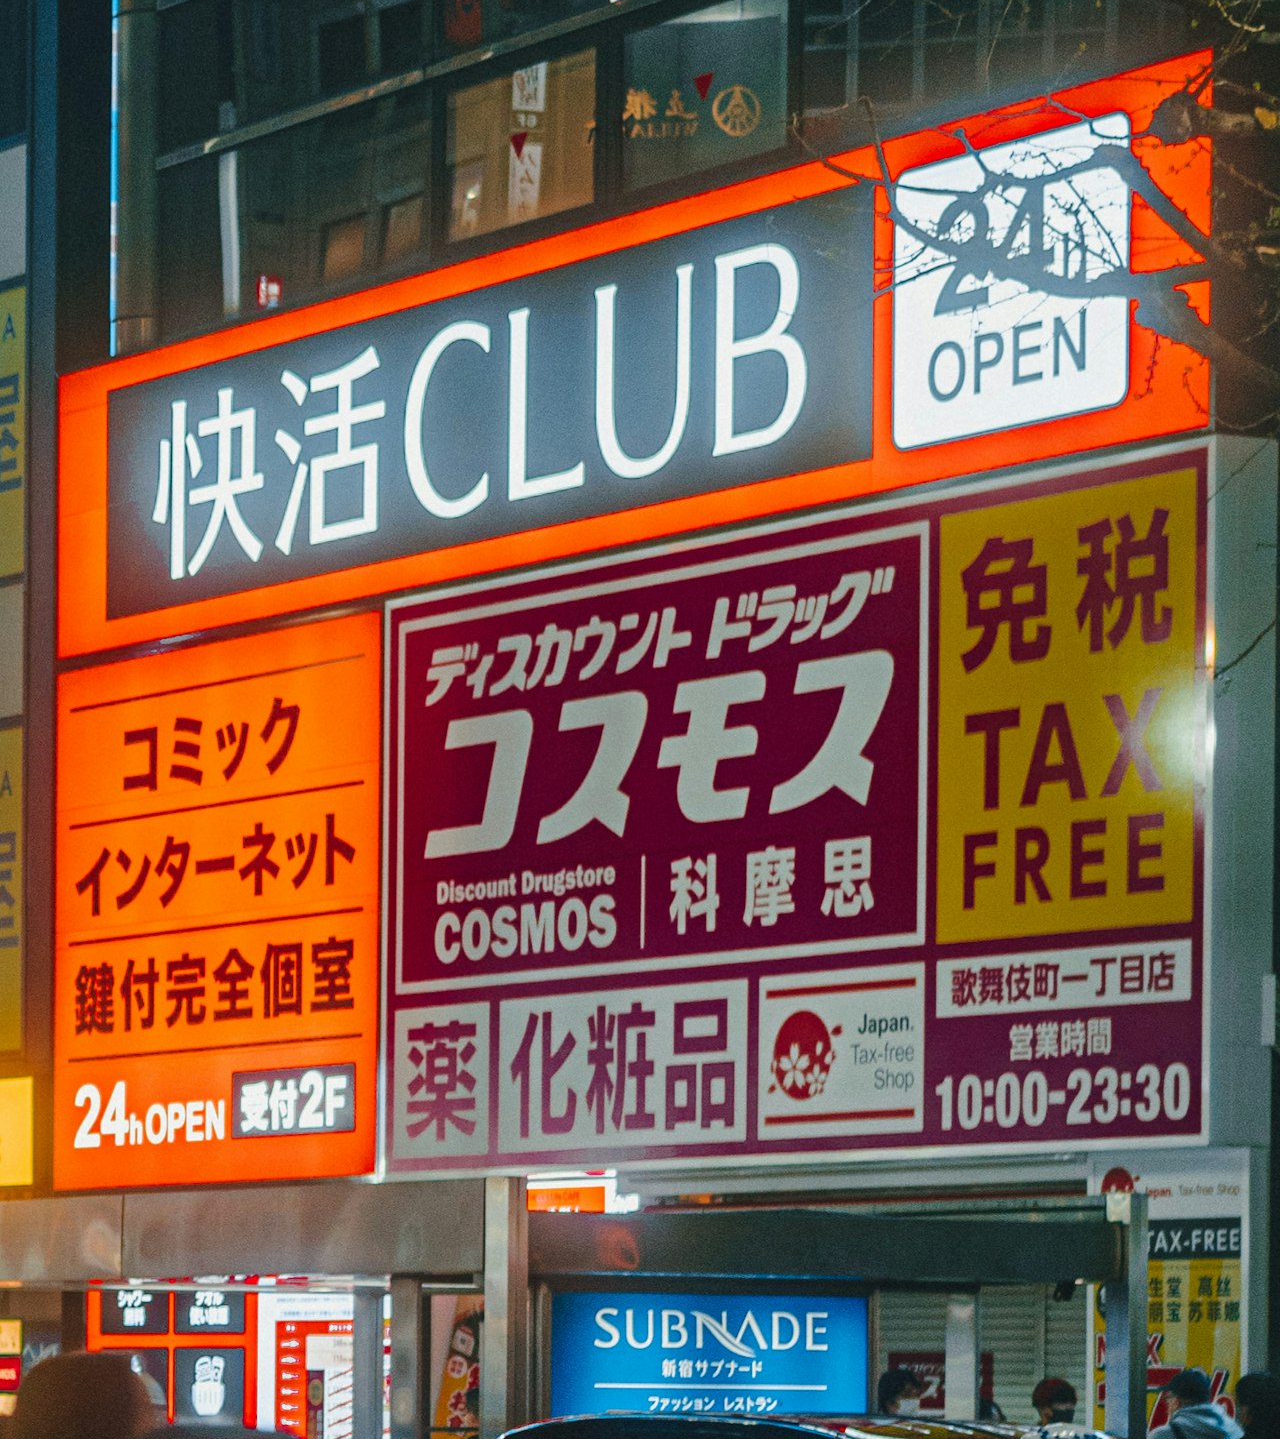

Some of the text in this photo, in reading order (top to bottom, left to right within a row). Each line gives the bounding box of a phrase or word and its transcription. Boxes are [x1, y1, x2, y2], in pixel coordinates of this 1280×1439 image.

[928, 304, 1087, 404] OPEN
[150, 241, 810, 582] 快活CLUB
[423, 564, 897, 708] ディスカウント ドラッグ
[958, 505, 1175, 675] 免税
[121, 697, 302, 795] コミック
[422, 648, 897, 862] コスモス
[961, 686, 1167, 813] TAX
[73, 812, 358, 918] インターネット
[435, 863, 618, 906] Discount Drugstore
[668, 834, 877, 936] 科摩思
[959, 811, 1169, 912] FREE
[433, 893, 618, 965] COSMOS
[73, 936, 357, 1037] 鍵付完全個室
[857, 1013, 915, 1038] Japan.
[950, 950, 1176, 1009] 歌舞伎町一丁目店
[403, 1016, 480, 1144] 薬
[509, 996, 738, 1142] 化粧品
[850, 1041, 916, 1066] Tax-free
[873, 1068, 916, 1094] Shop
[1009, 1016, 1113, 1063] 営業時間
[238, 1068, 348, 1135] 受付2F
[934, 1061, 1191, 1133] 10:00-23:30
[593, 1307, 830, 1358] SUBNADE
[661, 1358, 763, 1379] 新宿サブナード
[647, 1395, 779, 1413] ファッション レストラン
